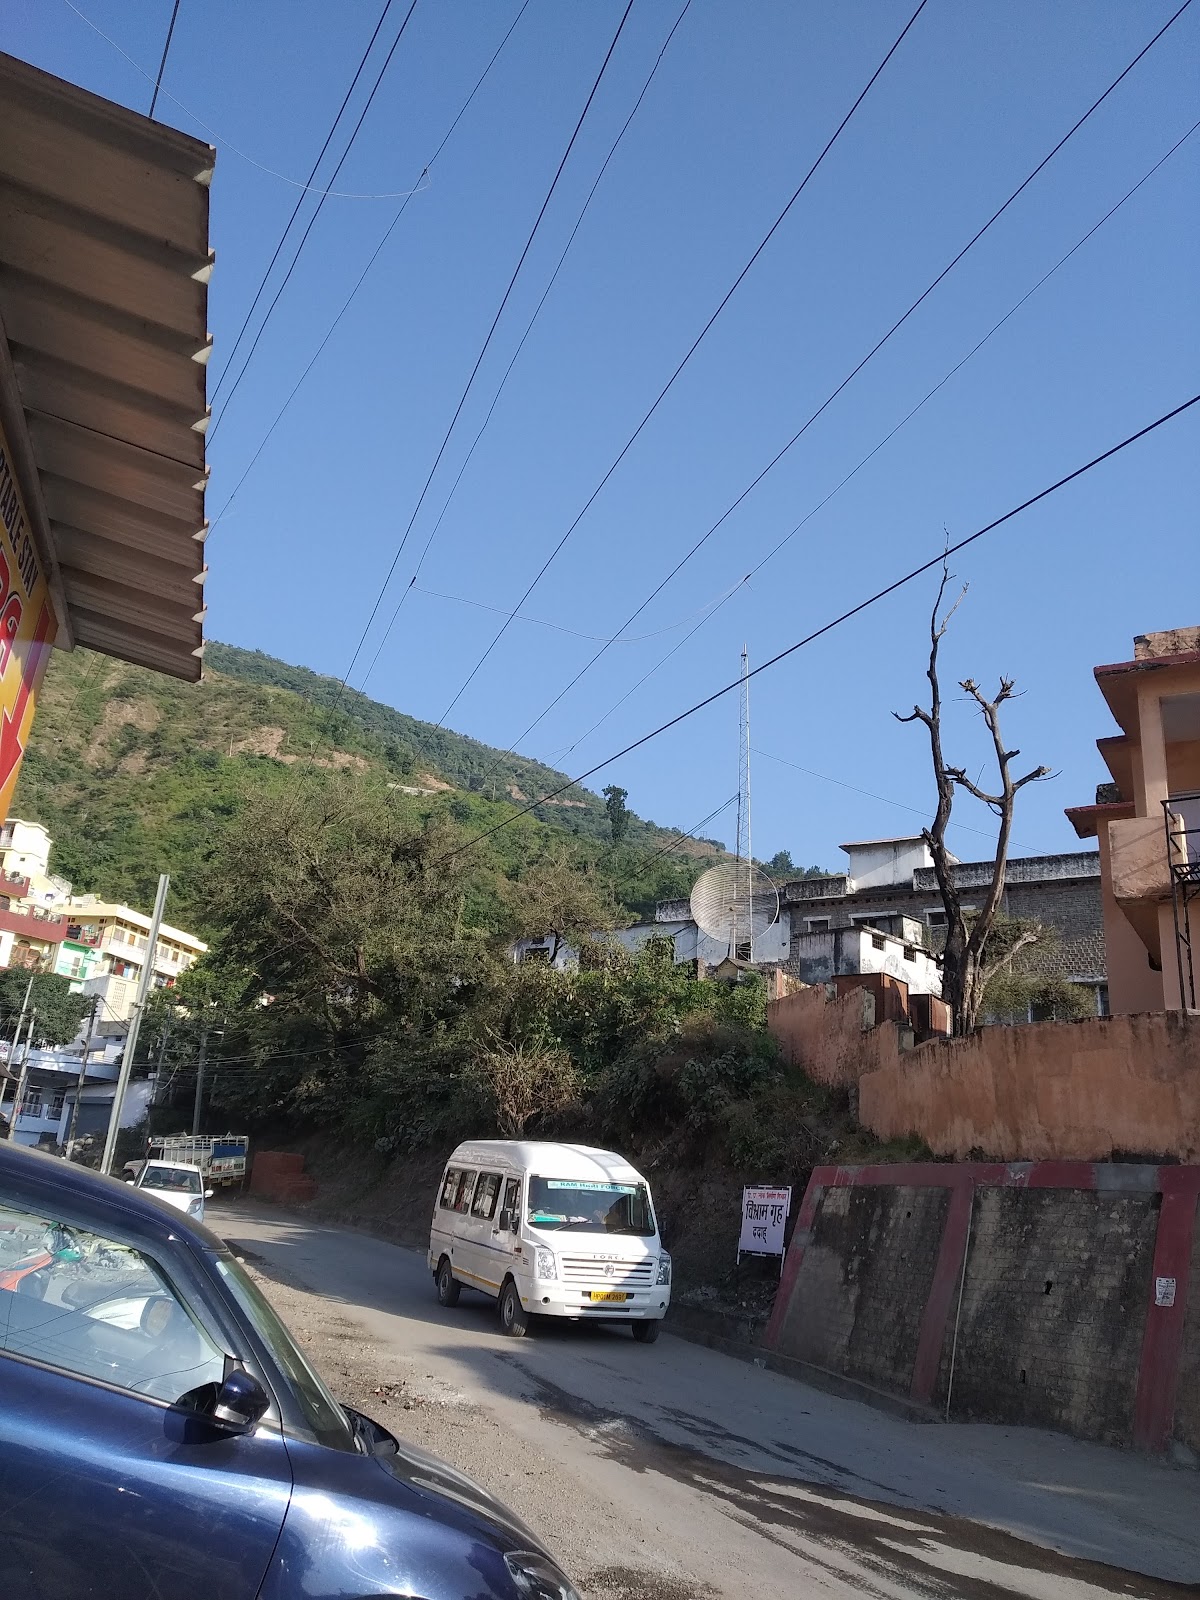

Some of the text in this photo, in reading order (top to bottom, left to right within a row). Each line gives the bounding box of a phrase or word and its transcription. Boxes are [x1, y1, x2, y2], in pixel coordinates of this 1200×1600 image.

[18, 533, 39, 598] STAY
[746, 1200, 784, 1227] विश्राम गृह
